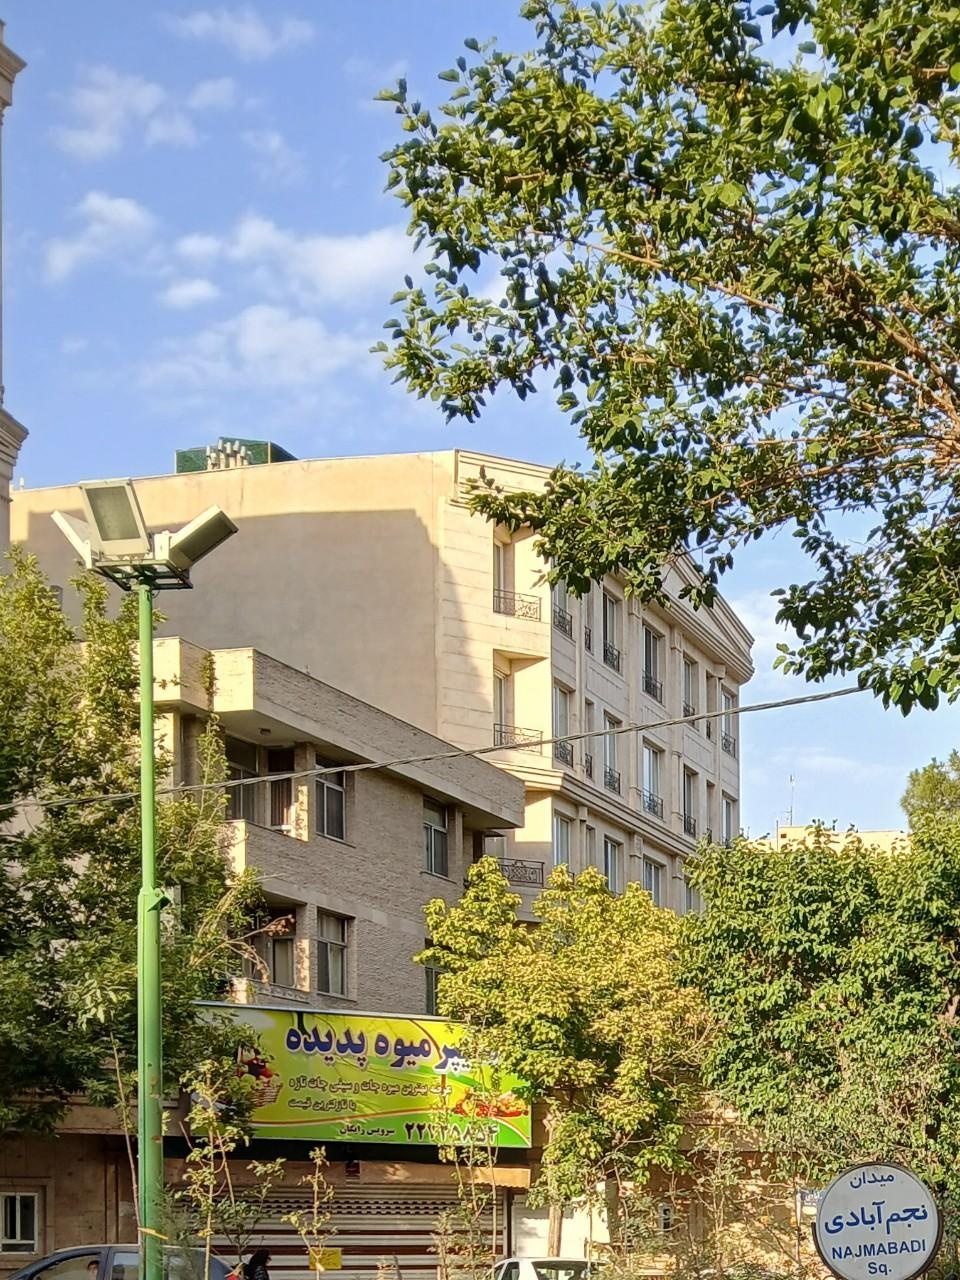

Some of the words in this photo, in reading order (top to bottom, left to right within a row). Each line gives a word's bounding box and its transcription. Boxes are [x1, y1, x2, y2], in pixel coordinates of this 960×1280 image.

[286, 1028, 366, 1067] پدیده
[374, 1034, 431, 1067] میوه
[339, 1123, 365, 1136] رایگان
[366, 1126, 395, 1137] سرویس
[849, 1171, 895, 1189] میدان
[831, 1239, 926, 1260] NAJMABADI
[867, 1261, 892, 1276] Sq.
